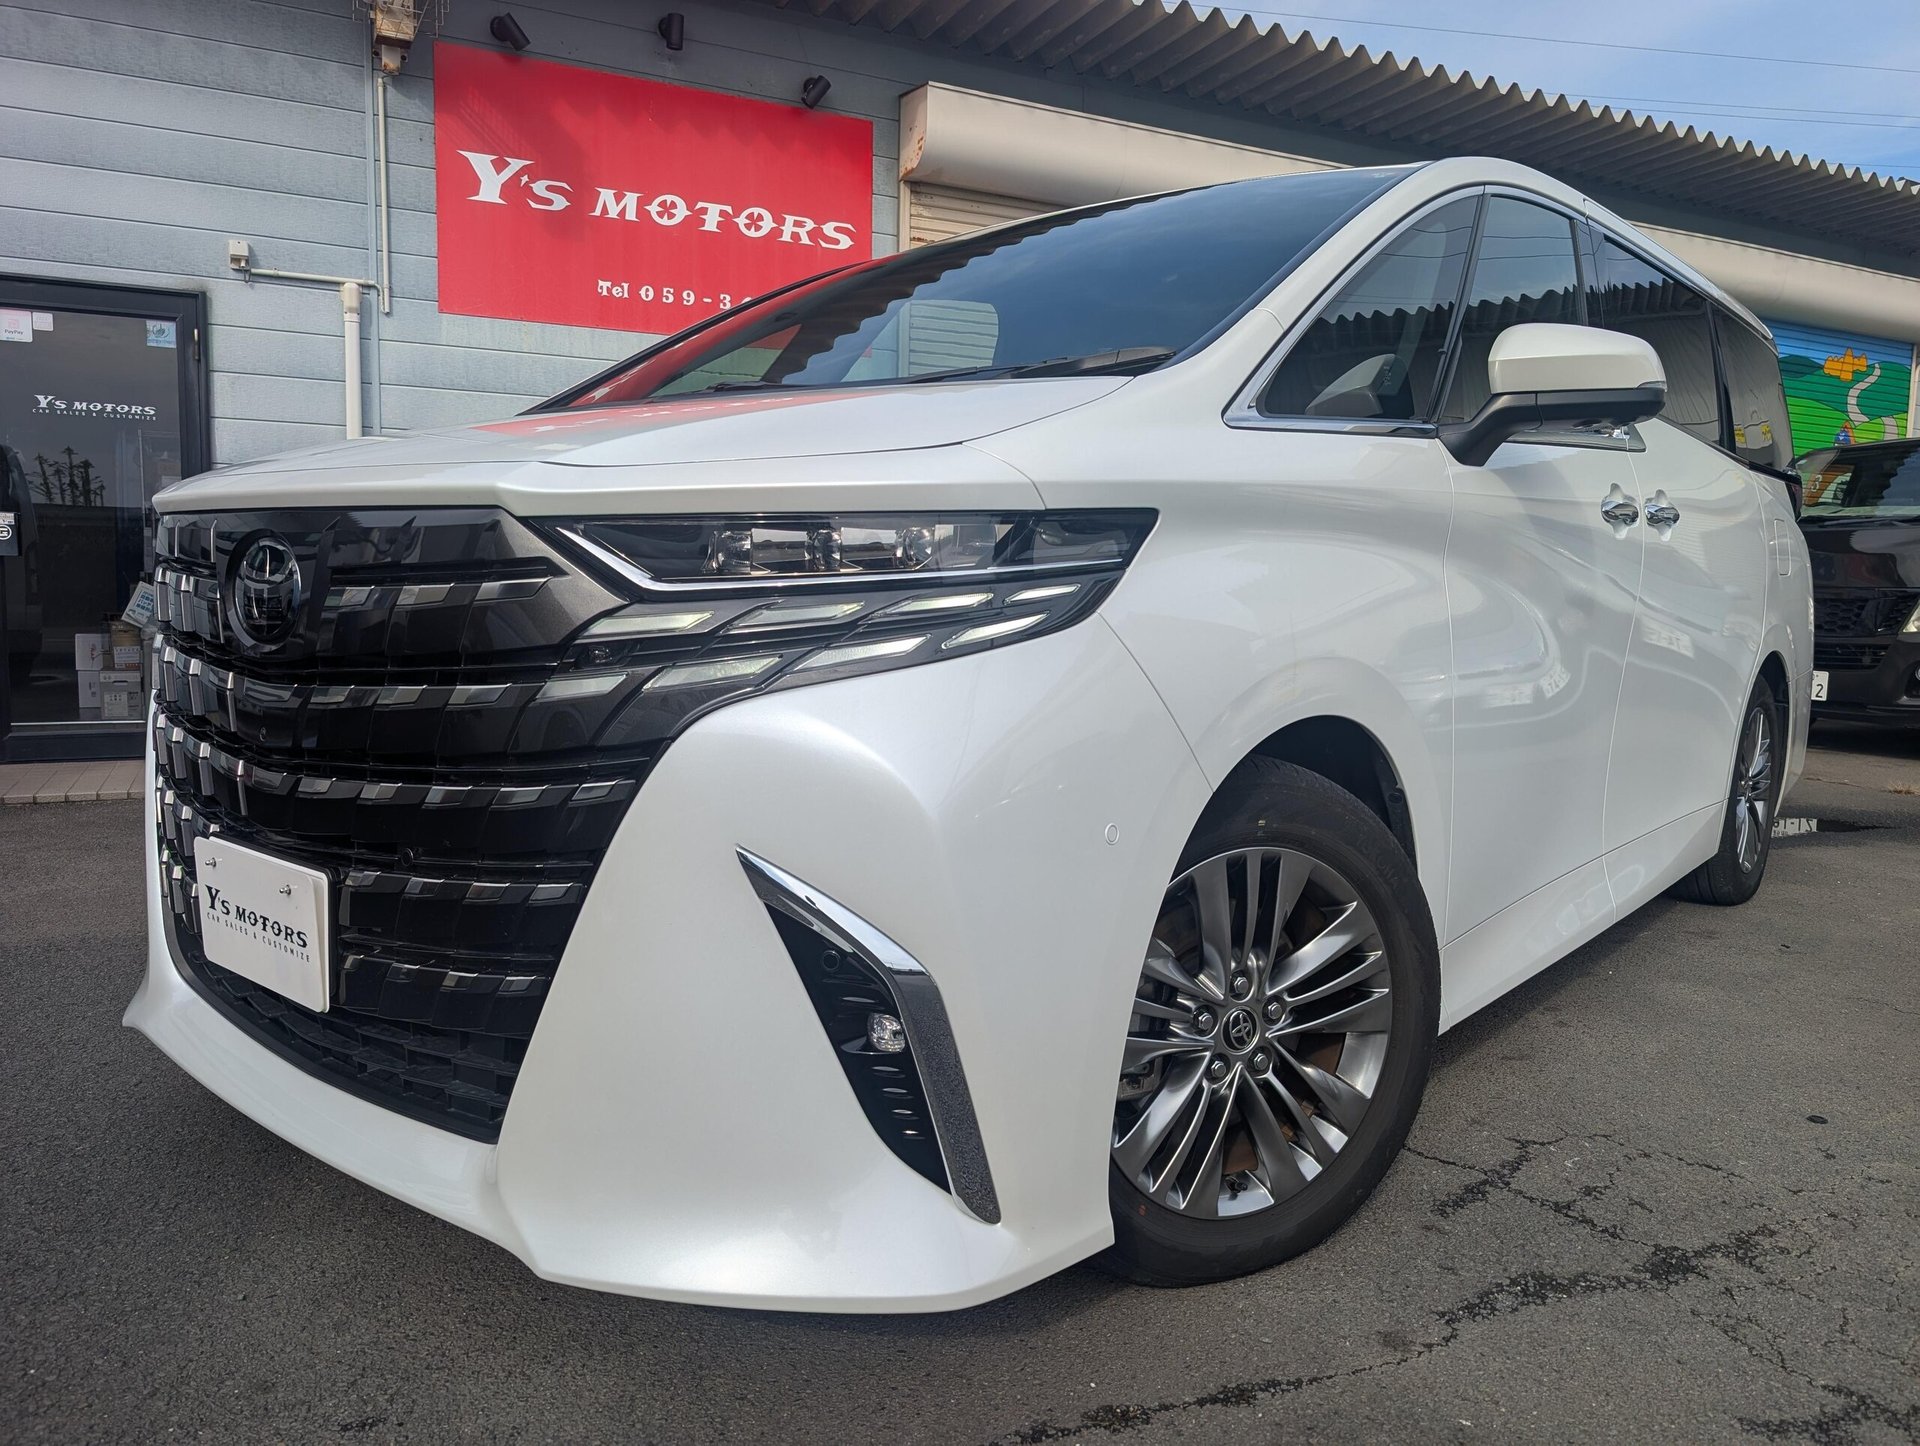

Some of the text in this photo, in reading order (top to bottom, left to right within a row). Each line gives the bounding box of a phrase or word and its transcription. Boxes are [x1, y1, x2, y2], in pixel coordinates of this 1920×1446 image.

[456, 149, 857, 250] Y's MOTORS
[597, 279, 630, 299] Tel
[34, 395, 156, 415] Y's MOTORS
[205, 884, 308, 948] Y's MOTORS
[206, 912, 220, 923] CAR
[225, 920, 248, 935] SALES
[263, 936, 310, 962] CUSTOMIZE
